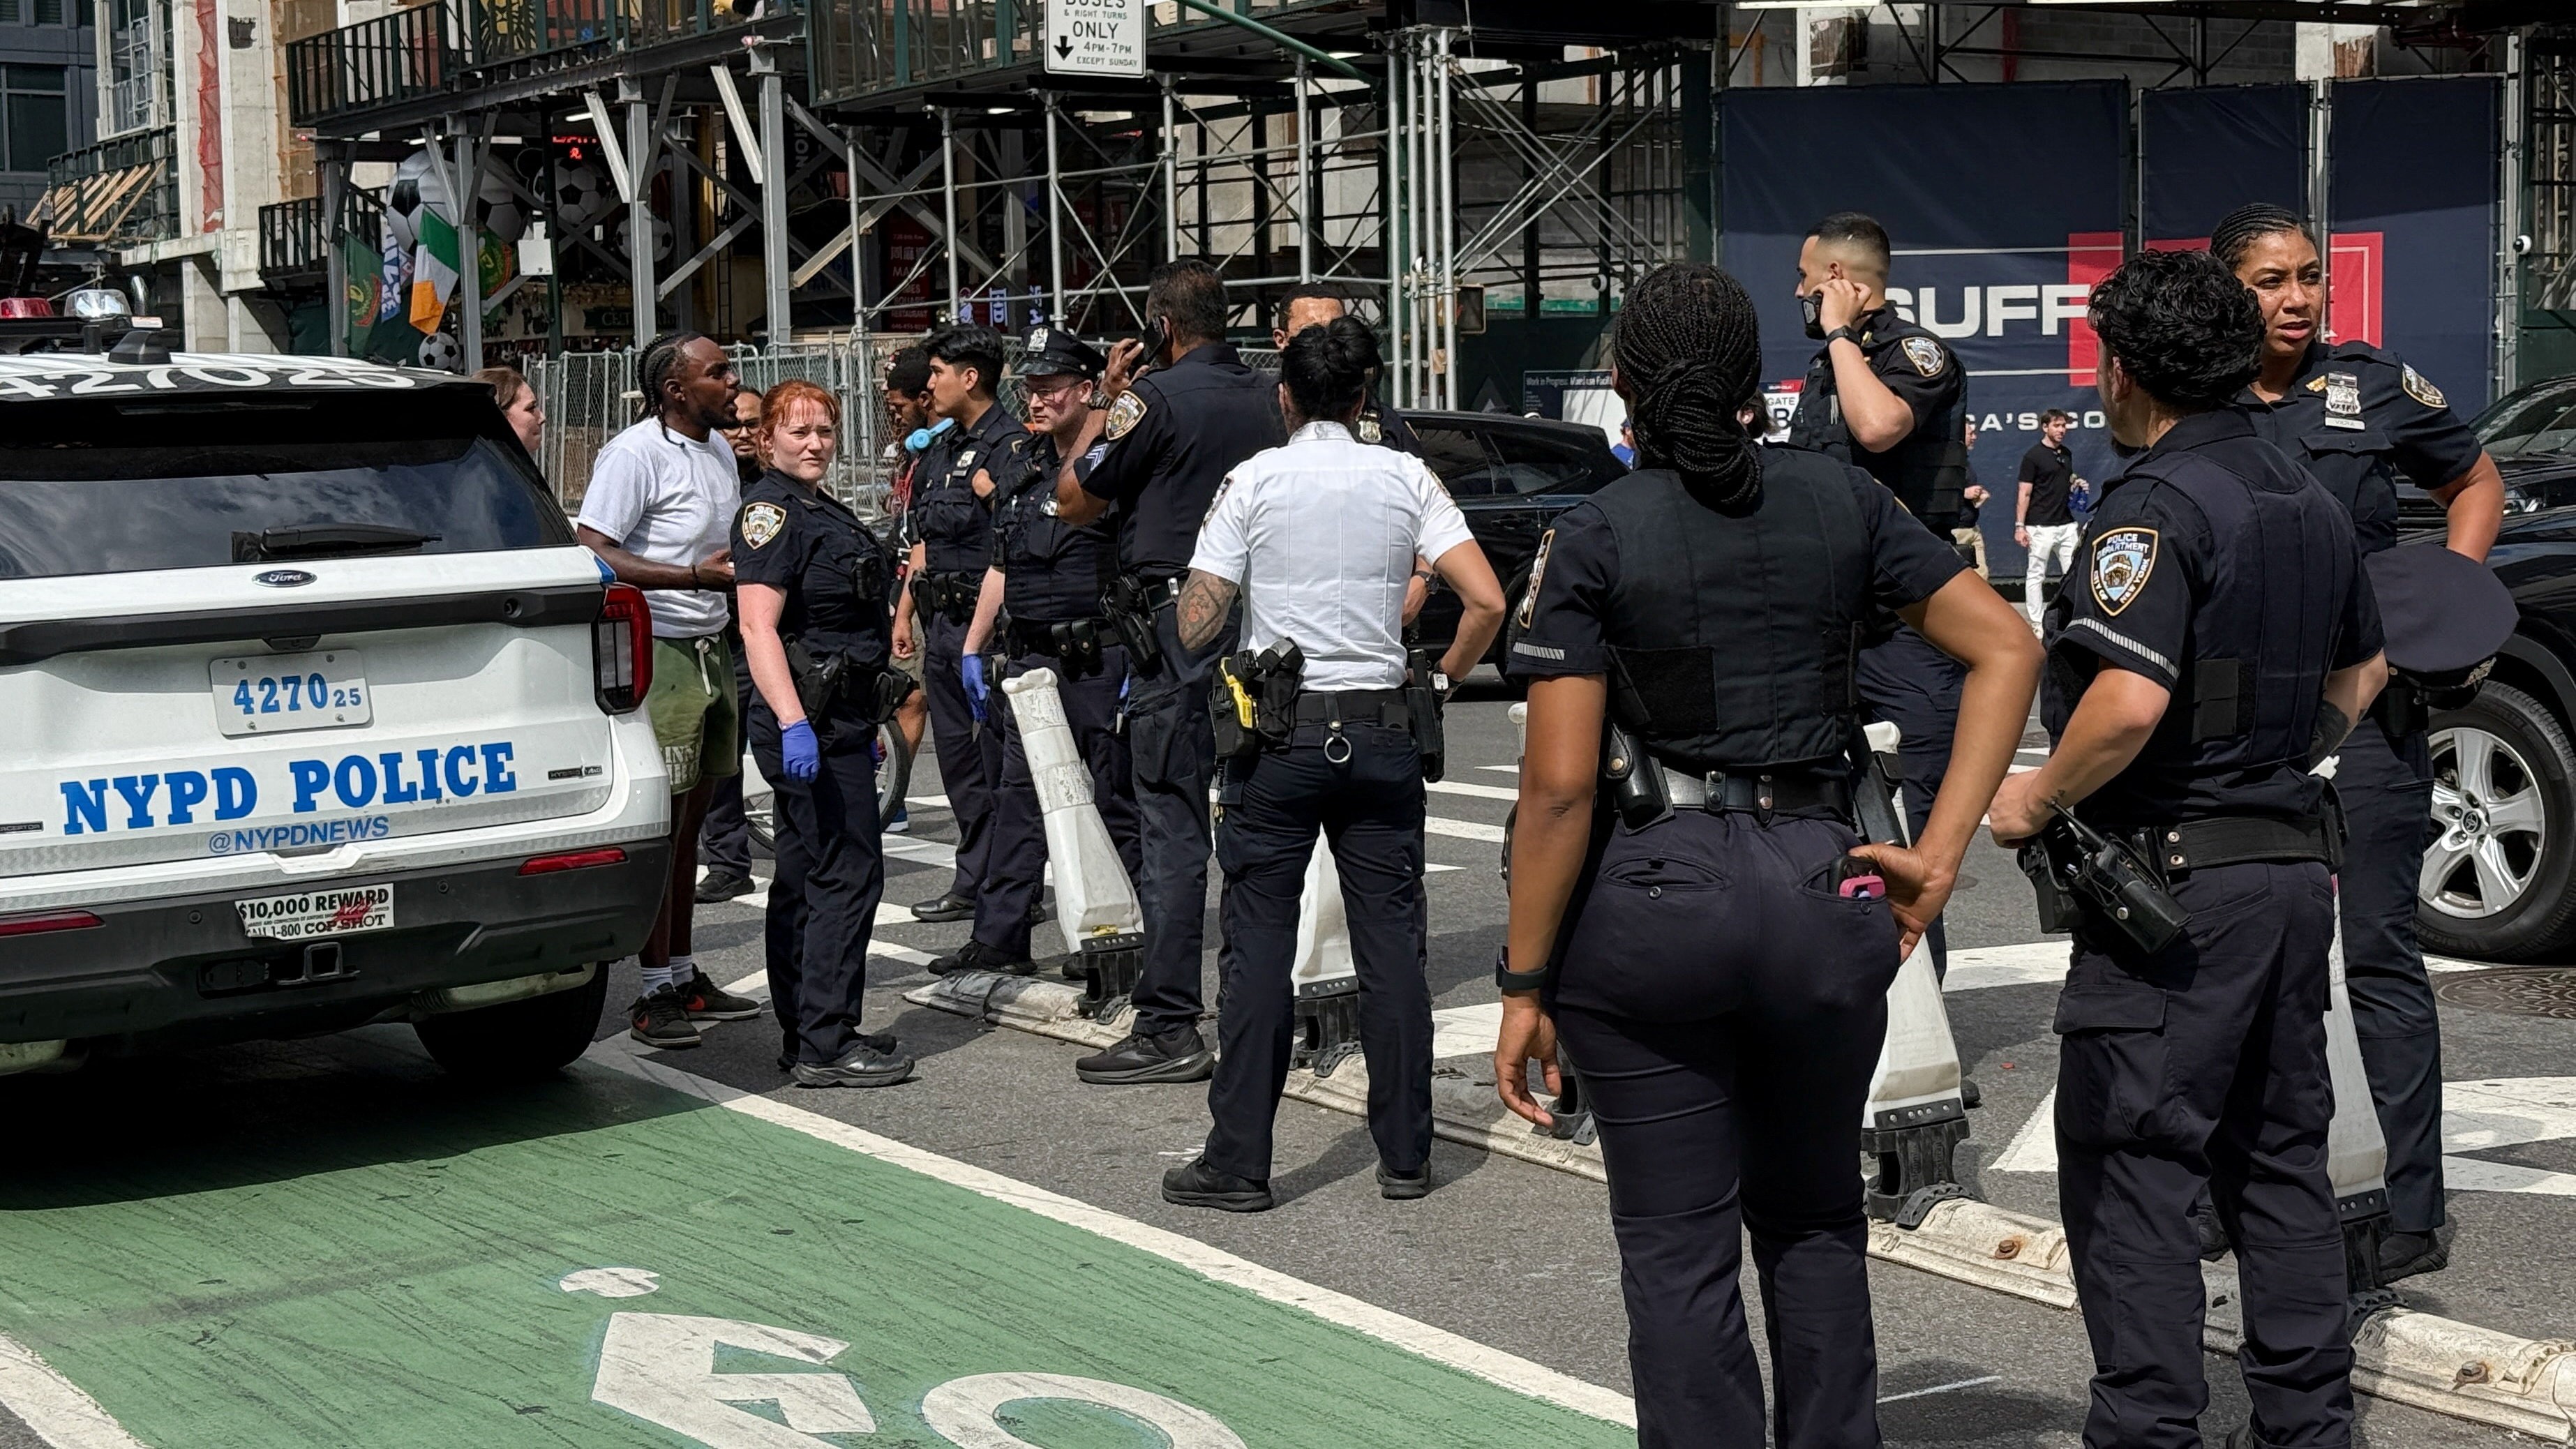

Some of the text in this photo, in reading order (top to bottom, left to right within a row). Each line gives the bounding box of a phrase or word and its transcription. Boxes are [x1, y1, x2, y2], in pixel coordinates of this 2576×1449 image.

[1075, 9, 1098, 17] RIGHT
[1102, 10, 1128, 20] TURNS
[1073, 21, 1118, 39] ONLY
[1077, 57, 1138, 68] EXCEPT SUNDAY
[893, 266, 926, 277] MA
[1767, 397, 1795, 405] GATE
[2106, 533, 2138, 544] POLICE
[2097, 542, 2150, 561] DEPARTMENT
[269, 572, 303, 582] Ford
[2092, 570, 2109, 601] CITY OF
[2120, 558, 2150, 603] NEW YORK
[234, 673, 361, 715] 4270 25
[60, 742, 517, 835] NYPD POLICE
[209, 816, 390, 854] @NYPDNEWS
[239, 897, 310, 920] $10,000
[315, 888, 389, 912] REWARD
[271, 923, 301, 937] 1-800
